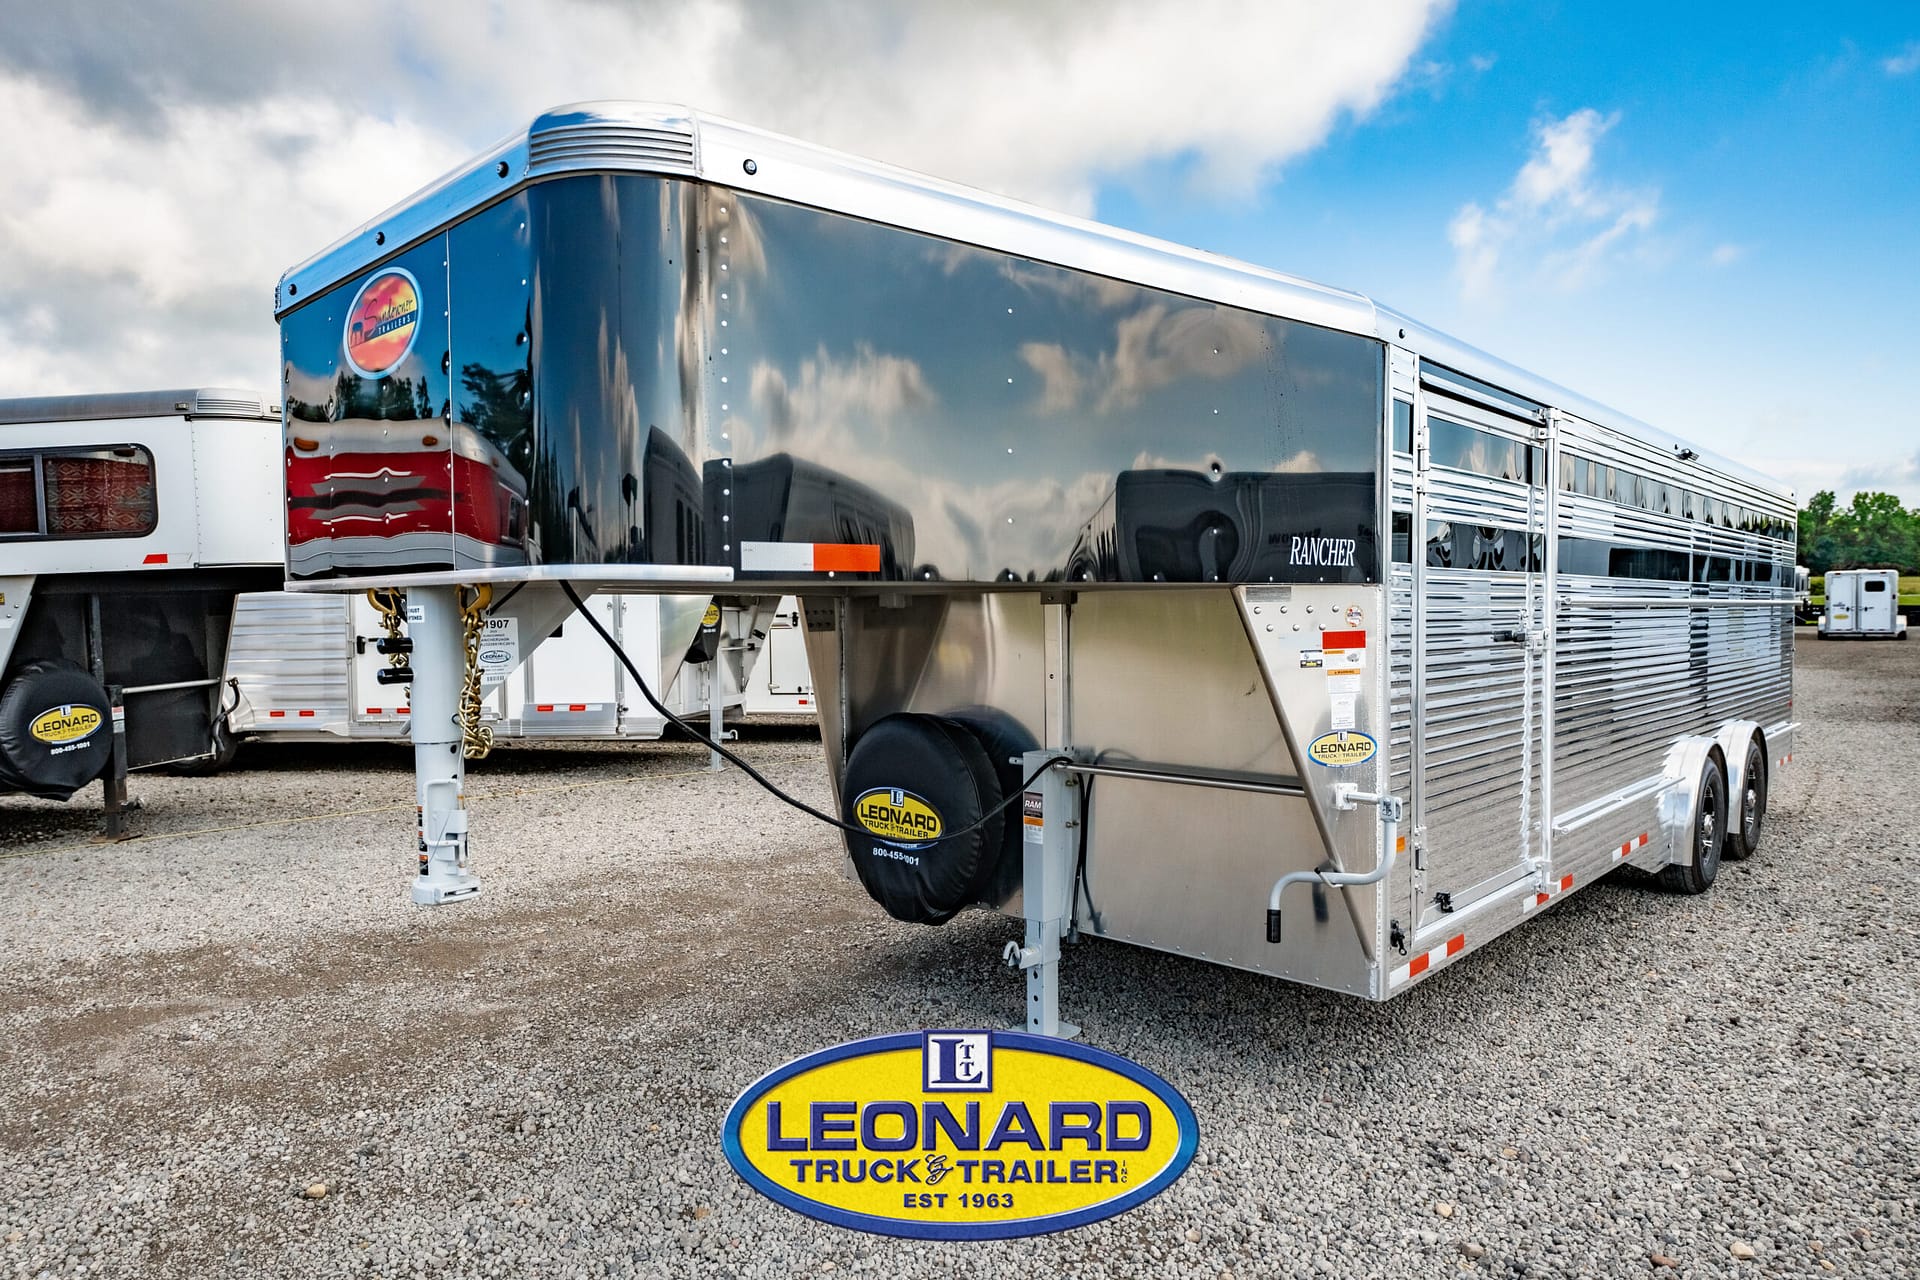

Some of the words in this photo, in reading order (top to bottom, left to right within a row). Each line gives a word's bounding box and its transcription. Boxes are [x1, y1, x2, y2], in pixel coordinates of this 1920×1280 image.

[378, 314, 412, 335] TRAILERS
[1289, 536, 1356, 567] RANCHER
[484, 619, 510, 629] 1907
[36, 714, 97, 733] LEONARD
[1314, 742, 1372, 754] LEONARD
[1024, 800, 1042, 809] RAM
[860, 803, 937, 832] LEONARD
[863, 819, 890, 831] TRUCK
[895, 825, 929, 838] TRAILER
